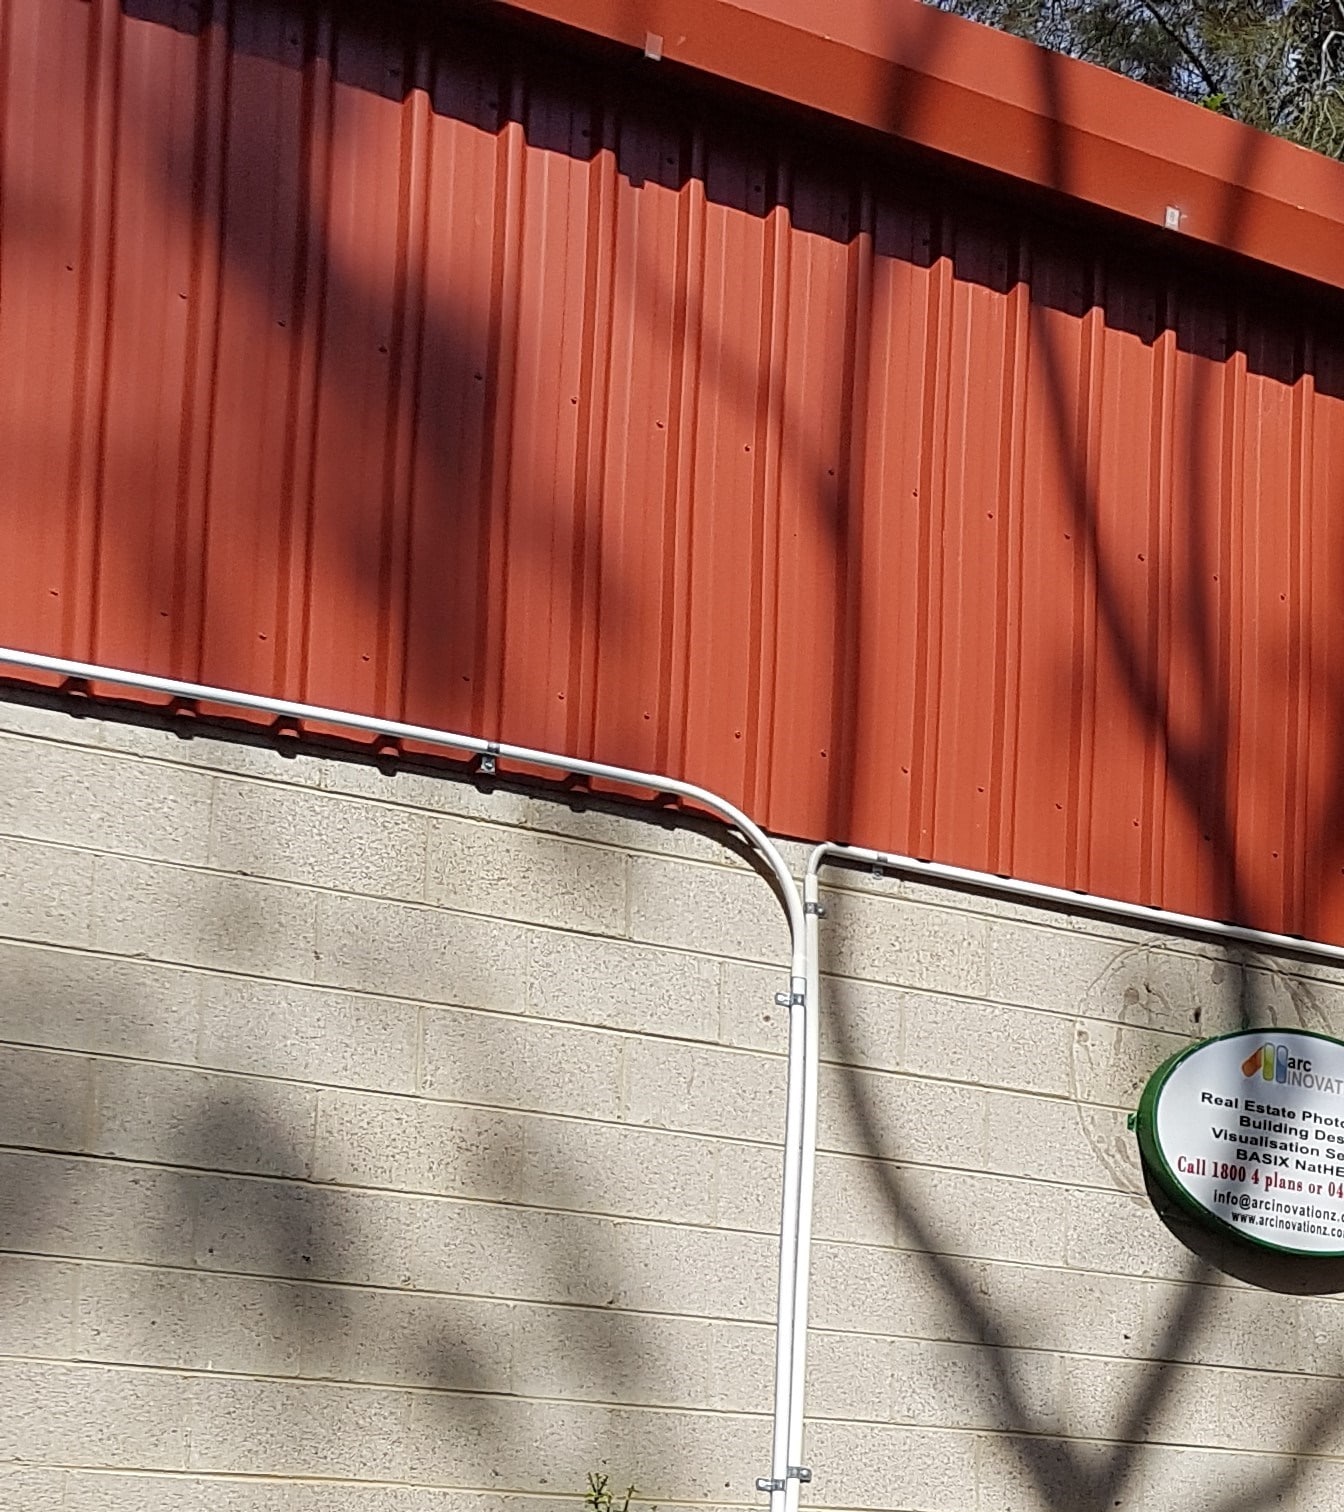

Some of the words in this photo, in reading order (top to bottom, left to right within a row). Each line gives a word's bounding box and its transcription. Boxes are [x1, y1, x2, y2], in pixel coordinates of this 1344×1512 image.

[1288, 1056, 1312, 1072] arc
[1201, 1092, 1239, 1109] Real
[1244, 1100, 1296, 1120] Estate
[1240, 1115, 1310, 1140] Building
[1211, 1126, 1320, 1156] Visualisation
[1236, 1148, 1290, 1168] BASIX
[1177, 1155, 1206, 1176] Call
[1212, 1162, 1246, 1182] 1800
[1251, 1168, 1260, 1184] 4
[1264, 1171, 1304, 1192] plans
[1308, 1182, 1323, 1196] or
